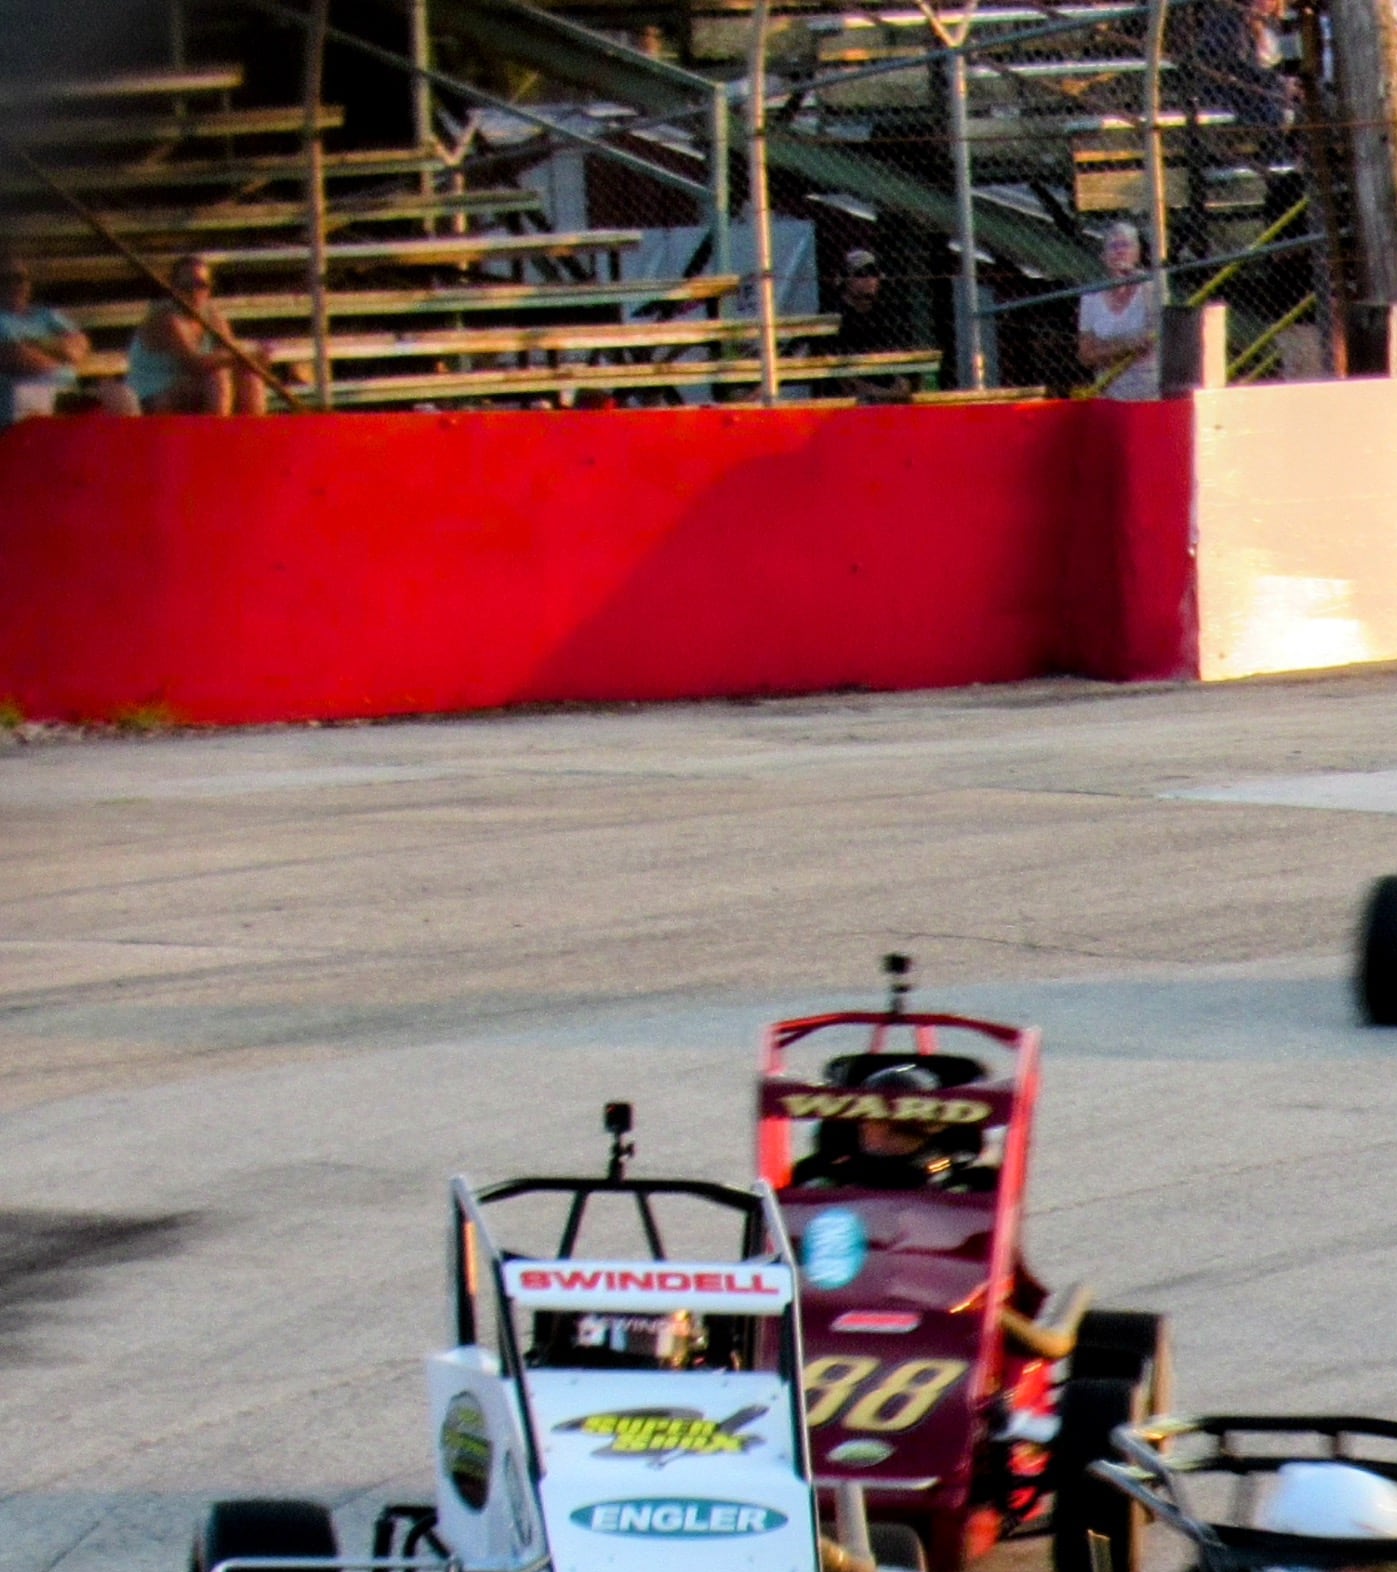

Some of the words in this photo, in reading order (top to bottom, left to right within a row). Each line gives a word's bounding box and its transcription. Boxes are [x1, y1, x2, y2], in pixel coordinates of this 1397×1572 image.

[779, 1092, 993, 1124] WARD
[519, 1269, 781, 1295] SWINDELL
[582, 1414, 718, 1437] SUPER
[590, 1503, 769, 1532] ENGLER
